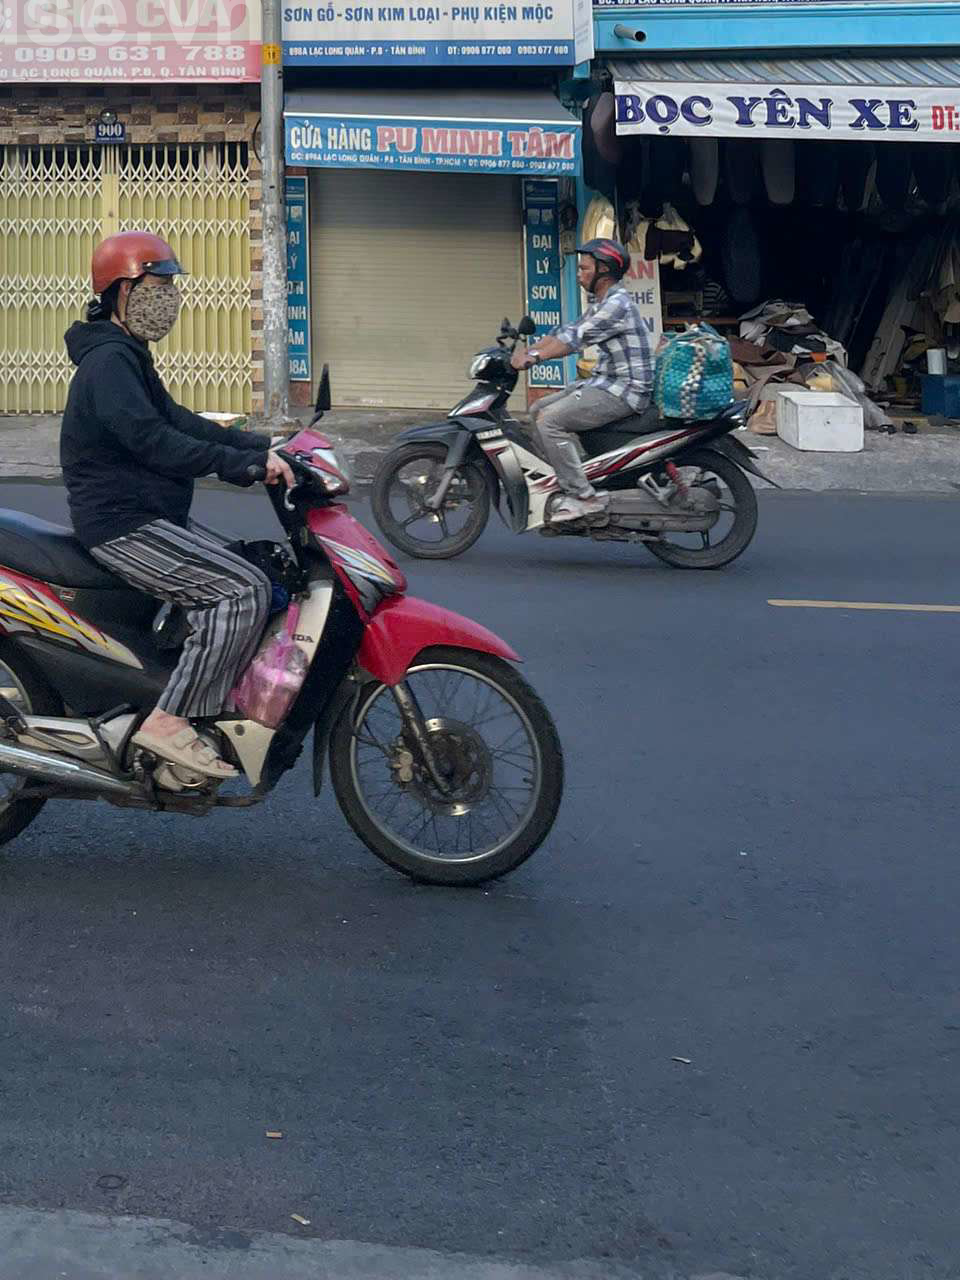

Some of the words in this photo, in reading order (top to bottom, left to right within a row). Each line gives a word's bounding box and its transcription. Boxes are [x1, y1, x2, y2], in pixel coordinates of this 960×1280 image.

[284, 7, 312, 21] SƠN
[317, 1, 335, 21] GỖ
[345, 7, 373, 21] SƠN
[378, 7, 405, 21] KIM
[409, 7, 440, 24] LOẠI
[451, 7, 480, 24] PHỤ
[484, 3, 517, 24] KIỆN
[522, 3, 554, 24] MỘC
[15, 46, 97, 62] 0909
[108, 45, 167, 61] 631
[181, 45, 246, 61] 788
[43, 67, 80, 78] LONG
[178, 65, 207, 77] TÂN
[615, 94, 714, 135] BỌC
[726, 88, 834, 131] YÊN
[848, 97, 920, 132] XE
[98, 123, 122, 137] 900
[291, 120, 322, 149] CỬA
[327, 123, 371, 150] HÀNG
[376, 126, 417, 152] PU
[421, 127, 503, 156] MINH
[508, 126, 575, 160] TÂM
[289, 231, 300, 248] ẠI
[533, 235, 552, 253] ĐẠI
[536, 257, 549, 275] LÝ
[531, 285, 557, 300] SƠN
[288, 306, 306, 321] INH
[531, 311, 560, 326] MINH
[288, 327, 304, 345] ÂM
[532, 365, 561, 381] 898A
